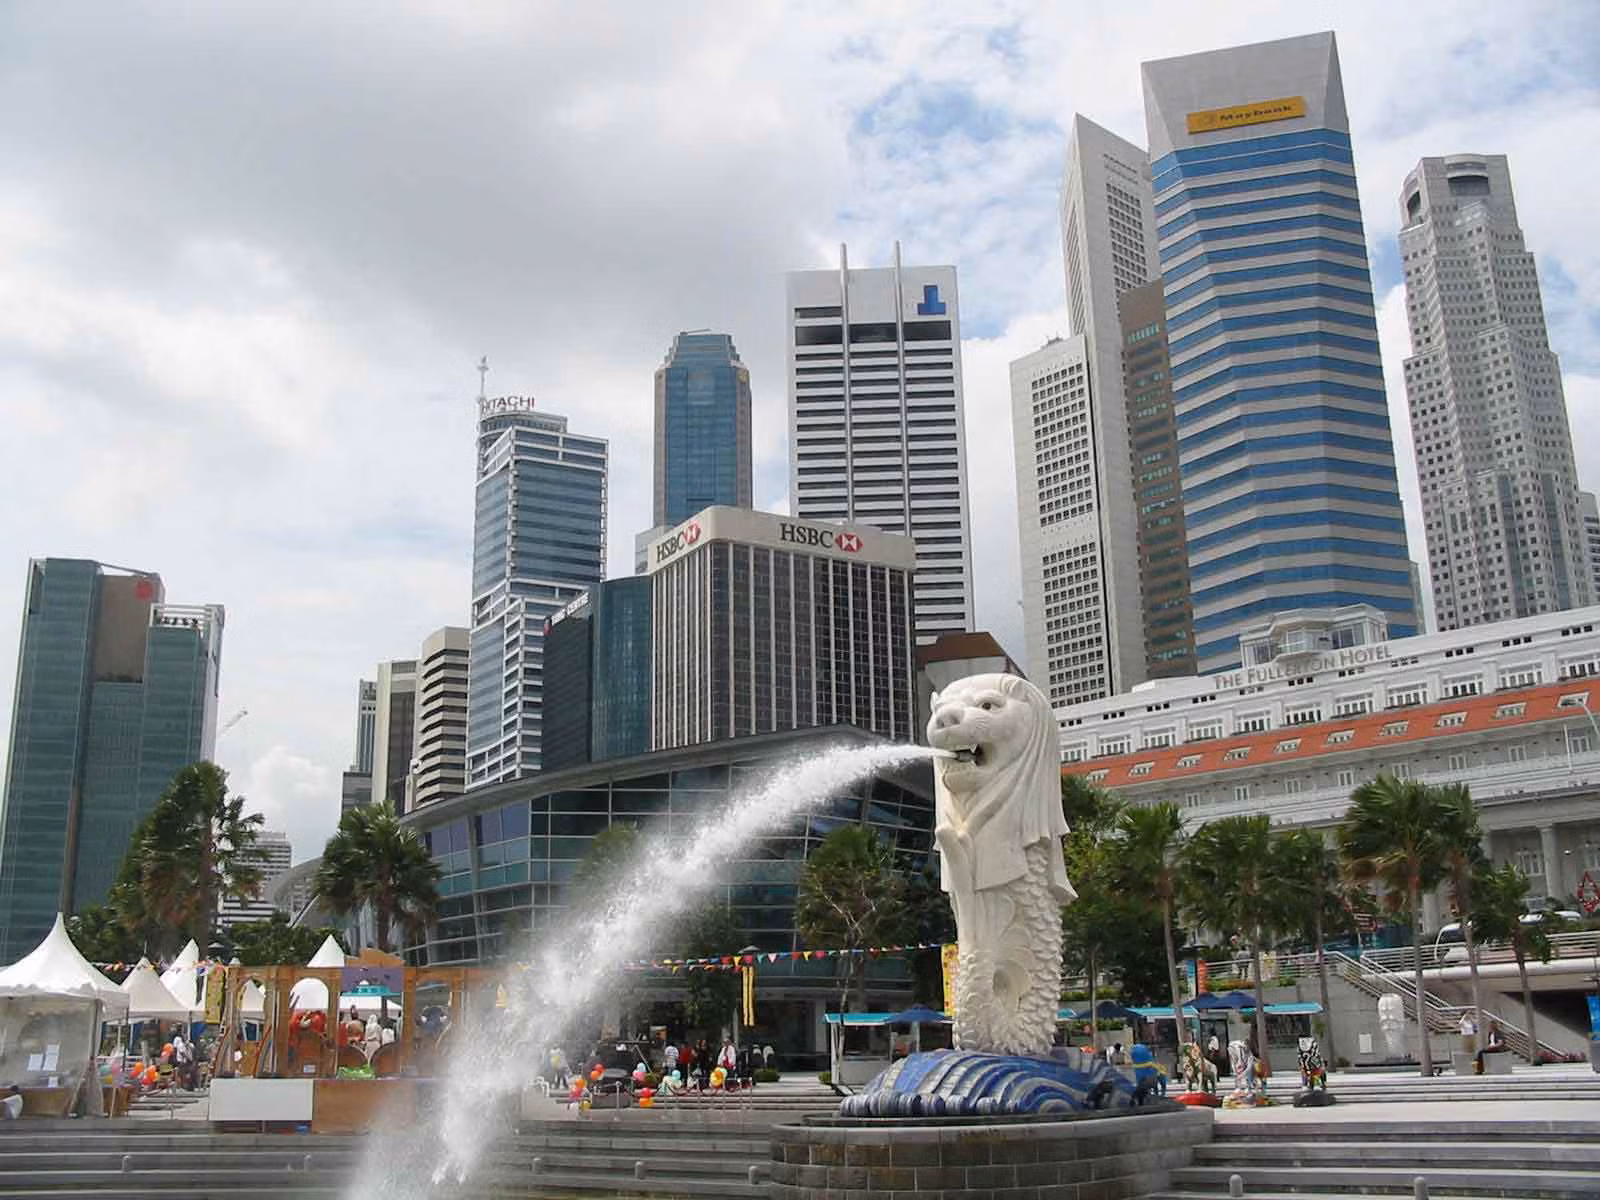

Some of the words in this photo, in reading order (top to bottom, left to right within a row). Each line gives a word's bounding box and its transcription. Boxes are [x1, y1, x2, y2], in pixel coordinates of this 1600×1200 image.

[656, 530, 686, 563] HSBC
[779, 522, 834, 548] HSBC
[1215, 673, 1243, 690] THE
[1339, 644, 1393, 667] HOTEL
